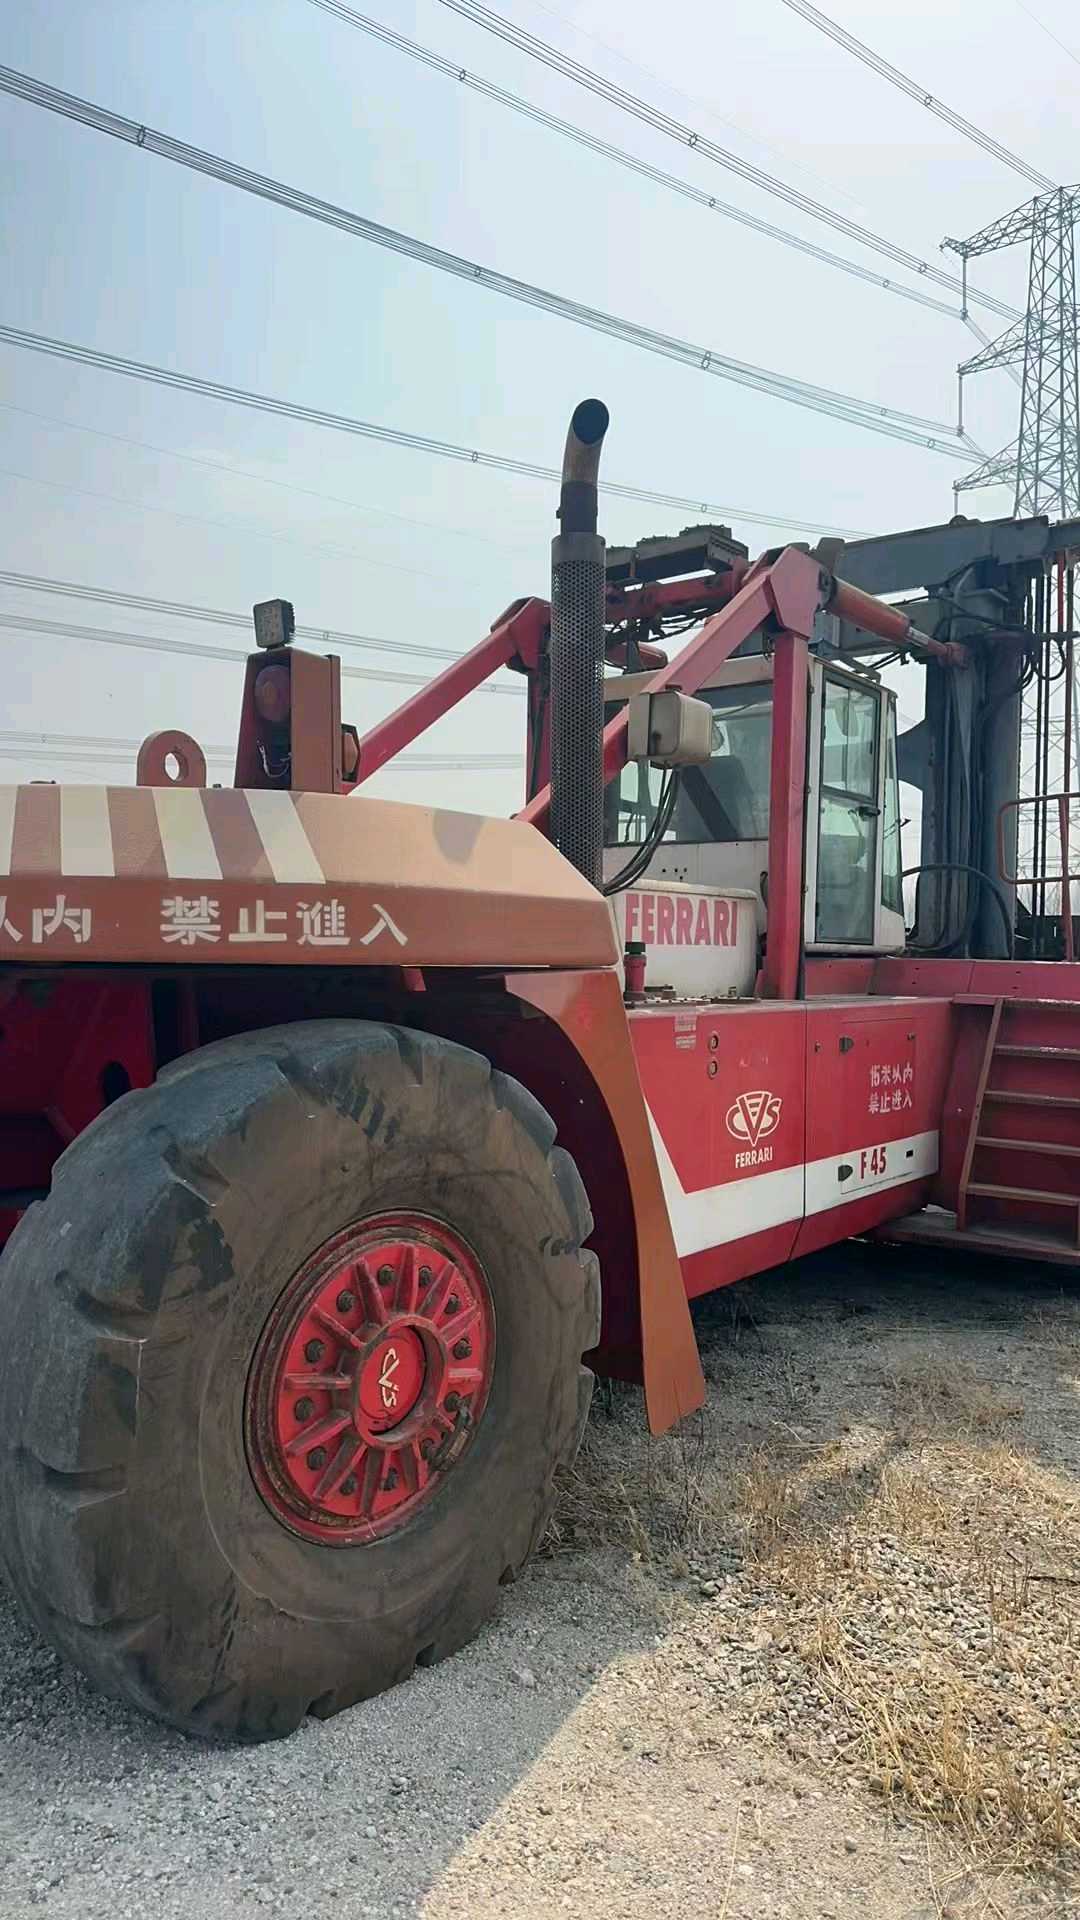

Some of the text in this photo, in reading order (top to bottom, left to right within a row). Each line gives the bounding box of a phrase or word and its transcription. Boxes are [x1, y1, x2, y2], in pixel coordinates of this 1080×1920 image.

[160, 895, 409, 946] 禁止進入
[625, 893, 738, 946] FERRARI
[735, 1146, 773, 1169] FERRARI
[860, 1147, 887, 1179] F 45
